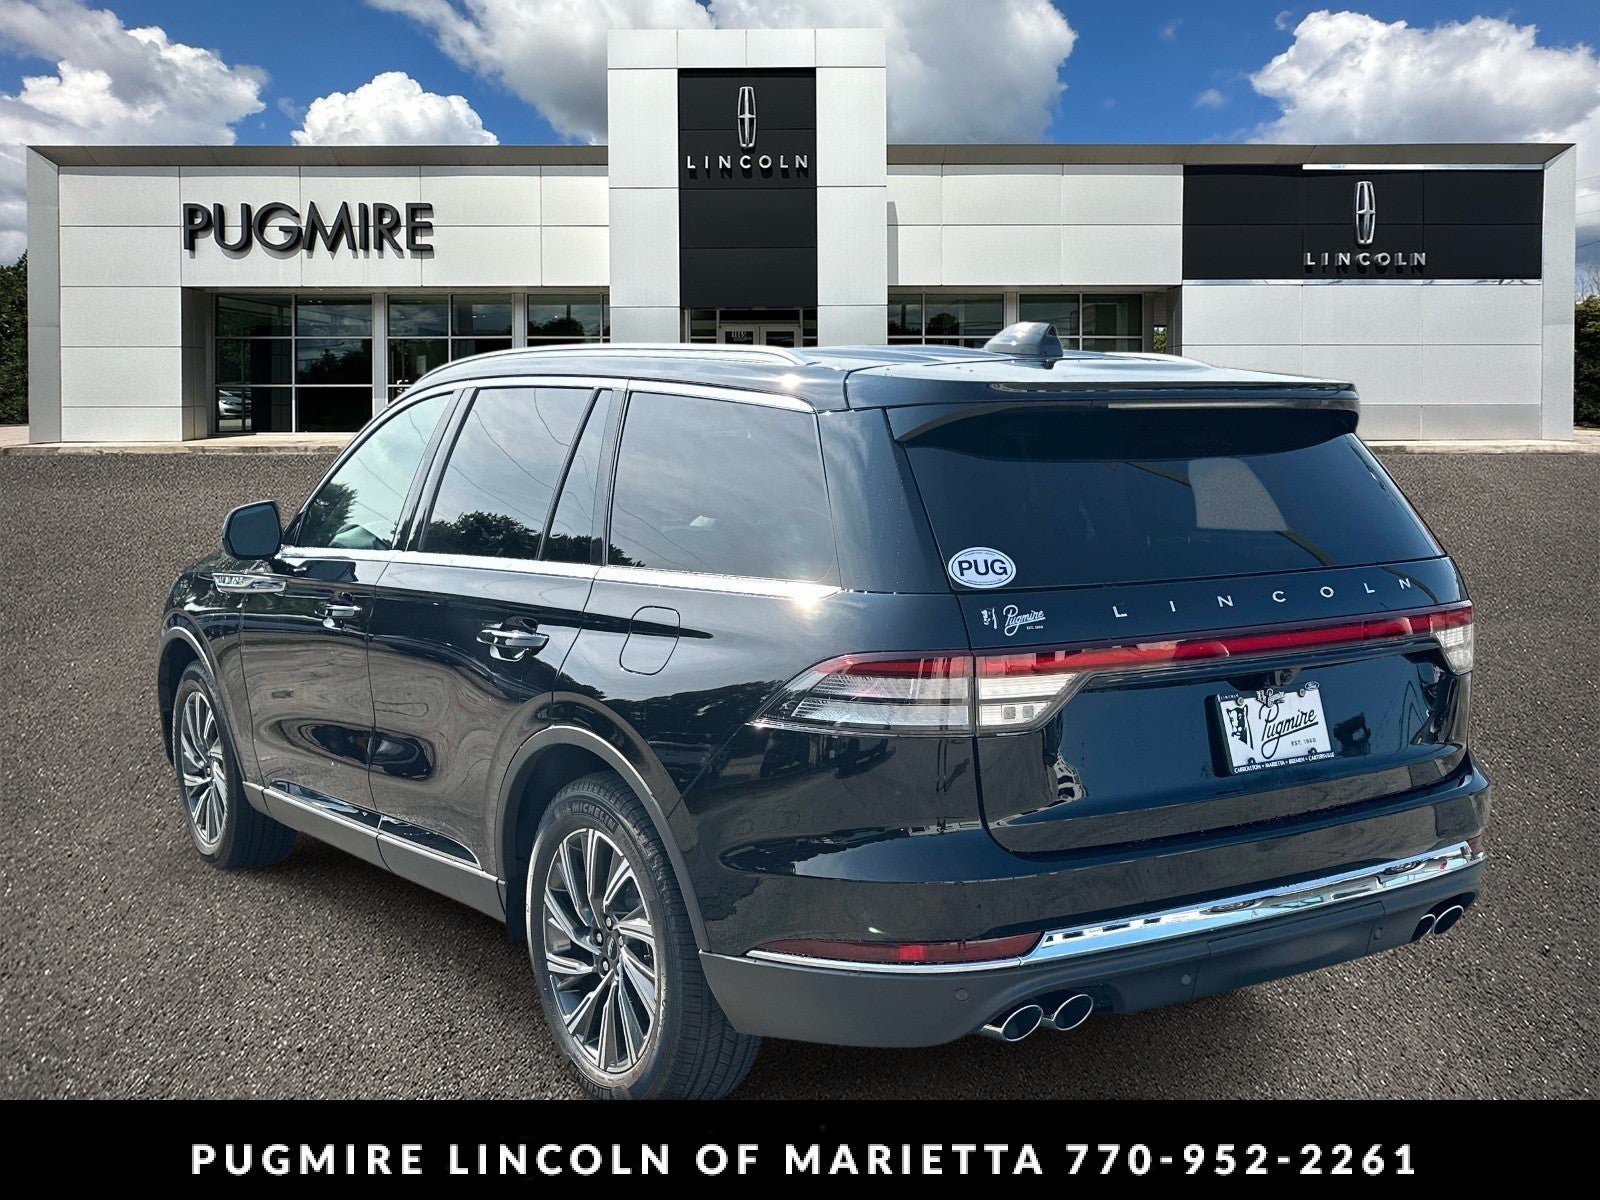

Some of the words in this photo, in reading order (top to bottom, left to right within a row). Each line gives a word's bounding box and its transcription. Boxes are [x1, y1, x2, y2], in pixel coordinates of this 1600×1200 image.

[686, 155, 808, 169] LINCOLN
[183, 201, 434, 252] PUGMIRE
[1305, 252, 1426, 266] LINCOLN
[958, 559, 1008, 577] PUG
[1112, 578, 1411, 618] LINCOLN
[1003, 604, 1046, 636] Pugmire
[1259, 702, 1319, 759] Pugmire
[571, 803, 616, 833] MICHELIN
